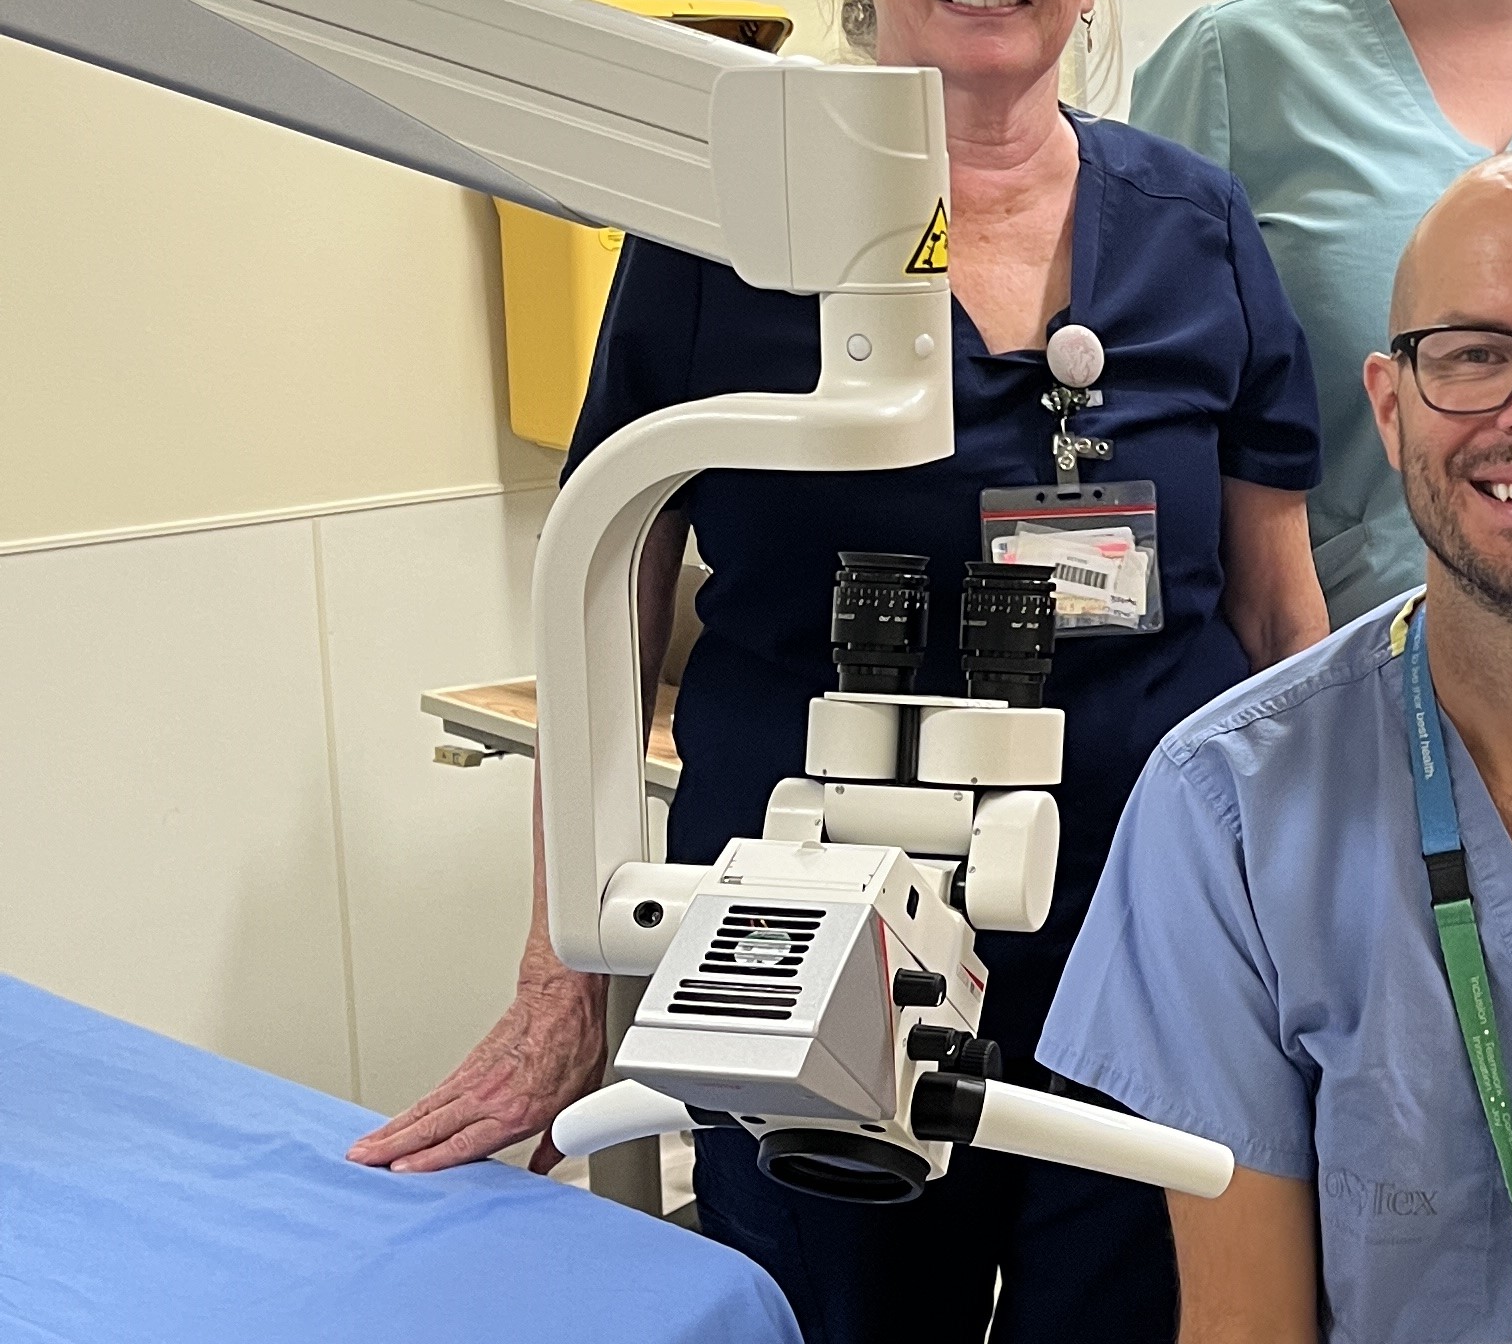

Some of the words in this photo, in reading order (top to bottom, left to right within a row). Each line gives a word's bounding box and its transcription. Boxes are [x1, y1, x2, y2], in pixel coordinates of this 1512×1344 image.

[1416, 711, 1429, 739] best
[1470, 975, 1487, 1025] Inclusion
[1472, 1035, 1492, 1092] Innovation
[1491, 1107, 1503, 1128] Joy
